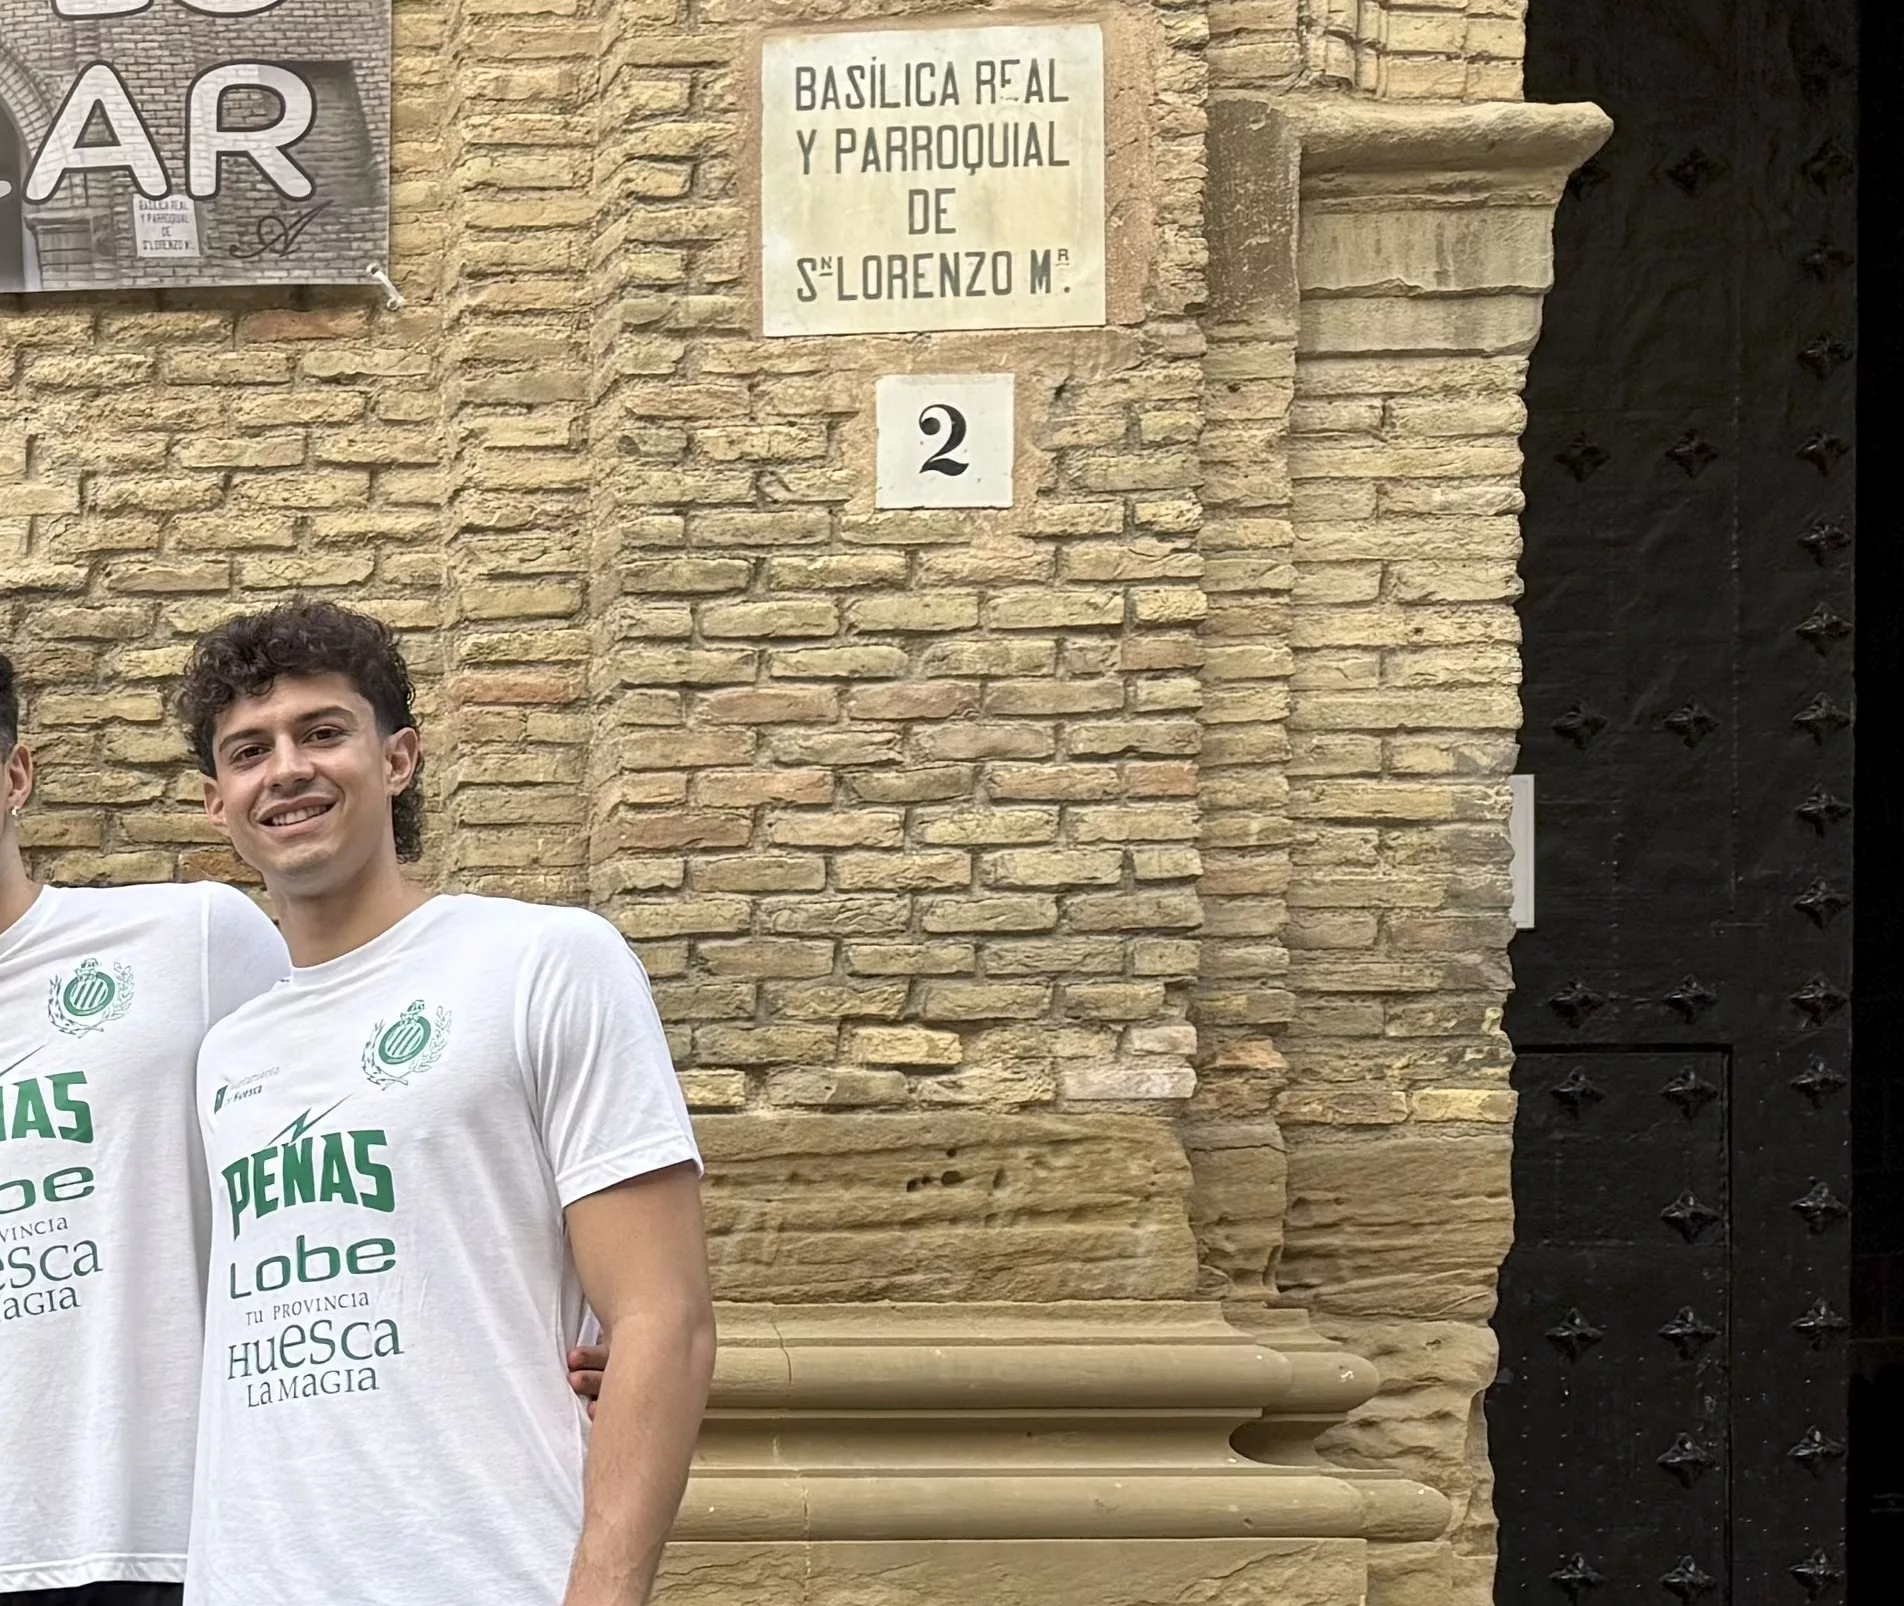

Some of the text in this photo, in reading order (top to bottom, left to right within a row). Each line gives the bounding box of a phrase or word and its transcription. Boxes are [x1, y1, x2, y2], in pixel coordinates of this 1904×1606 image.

[976, 58, 1069, 105] REAL
[796, 121, 1070, 174] Y PARROQUIAL
[908, 188, 957, 235] DE
[918, 404, 970, 477] 2
[221, 1094, 396, 1242] PEÑAS
[230, 1235, 396, 1300] Lobe
